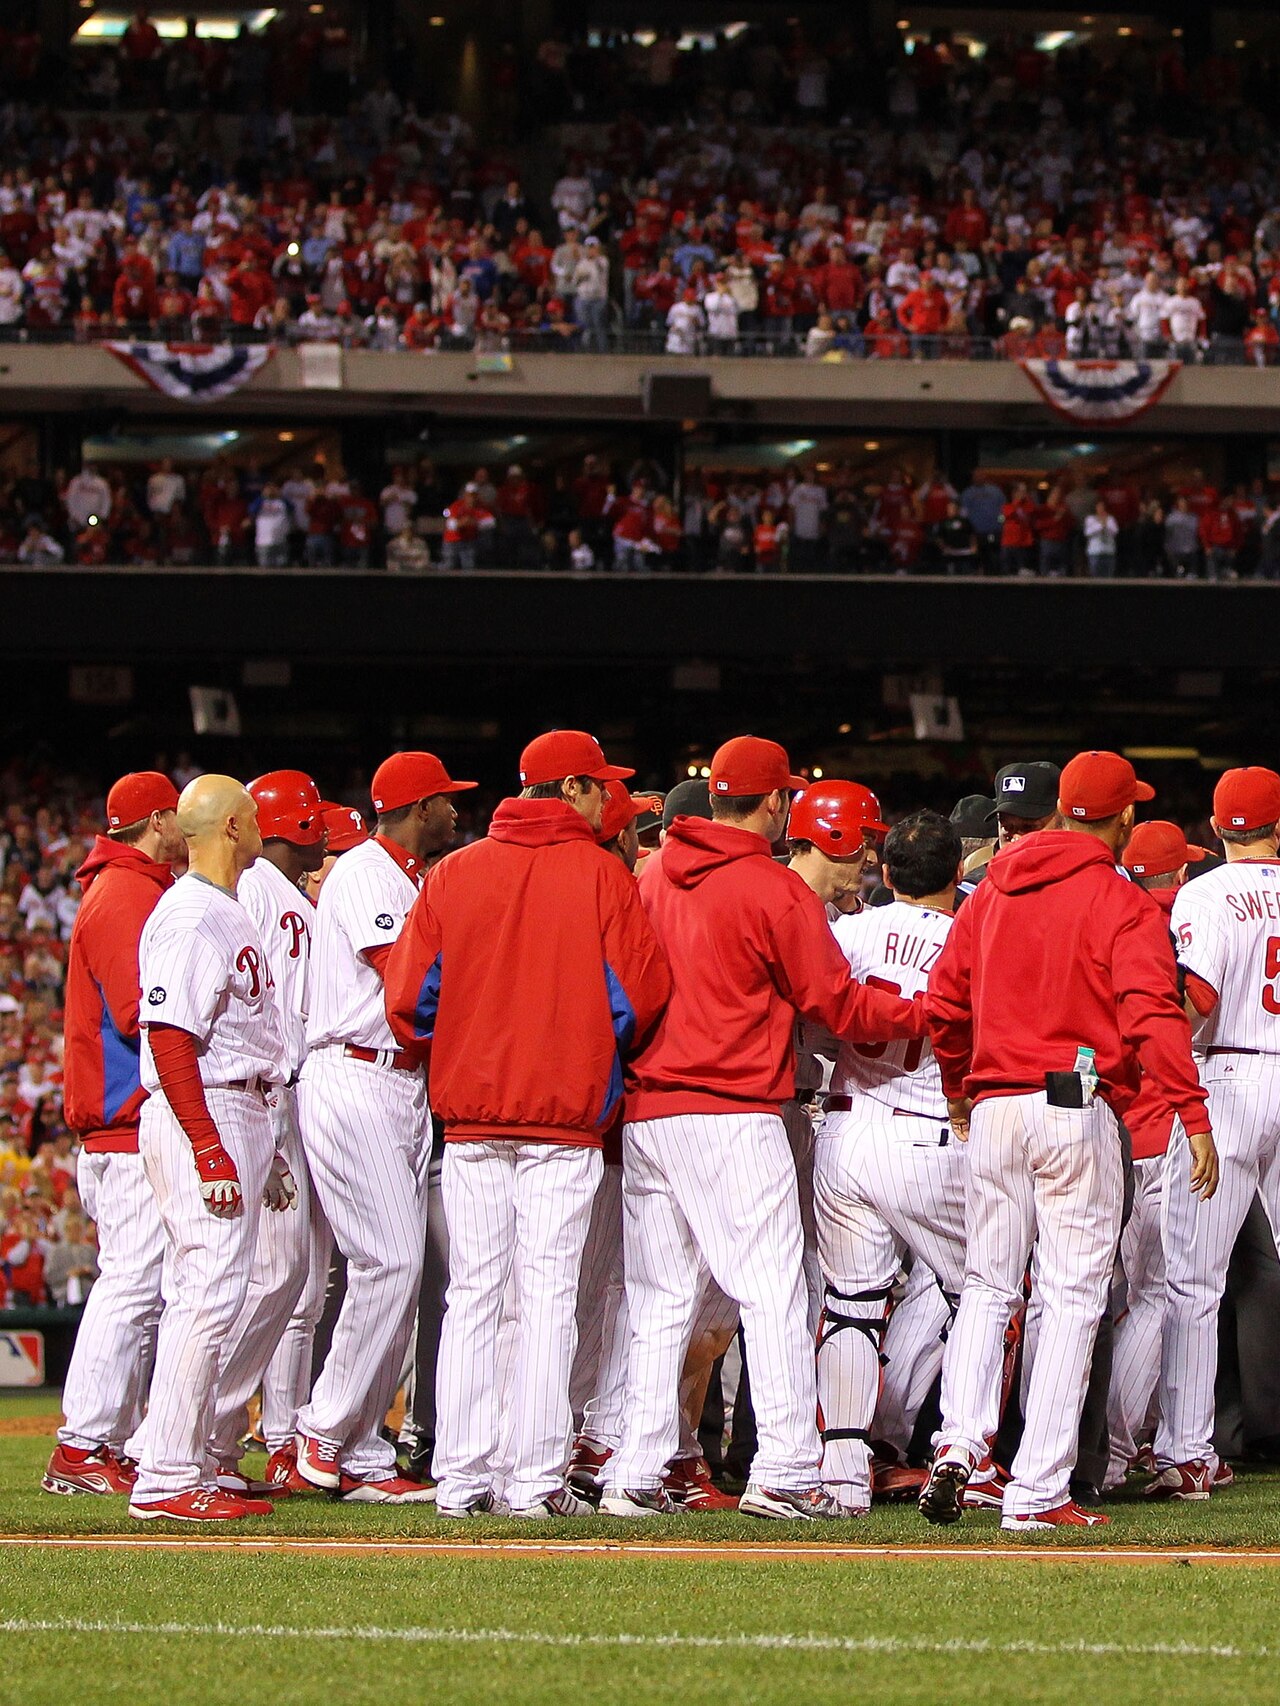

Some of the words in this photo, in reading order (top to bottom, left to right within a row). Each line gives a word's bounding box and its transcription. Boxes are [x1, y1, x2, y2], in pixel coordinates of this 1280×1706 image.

[350, 811, 362, 830] P
[377, 916, 393, 928] 36
[280, 911, 312, 959] P
[1178, 922, 1193, 948] 5
[884, 932, 944, 974] RUIZ
[150, 990, 165, 1003] 36
